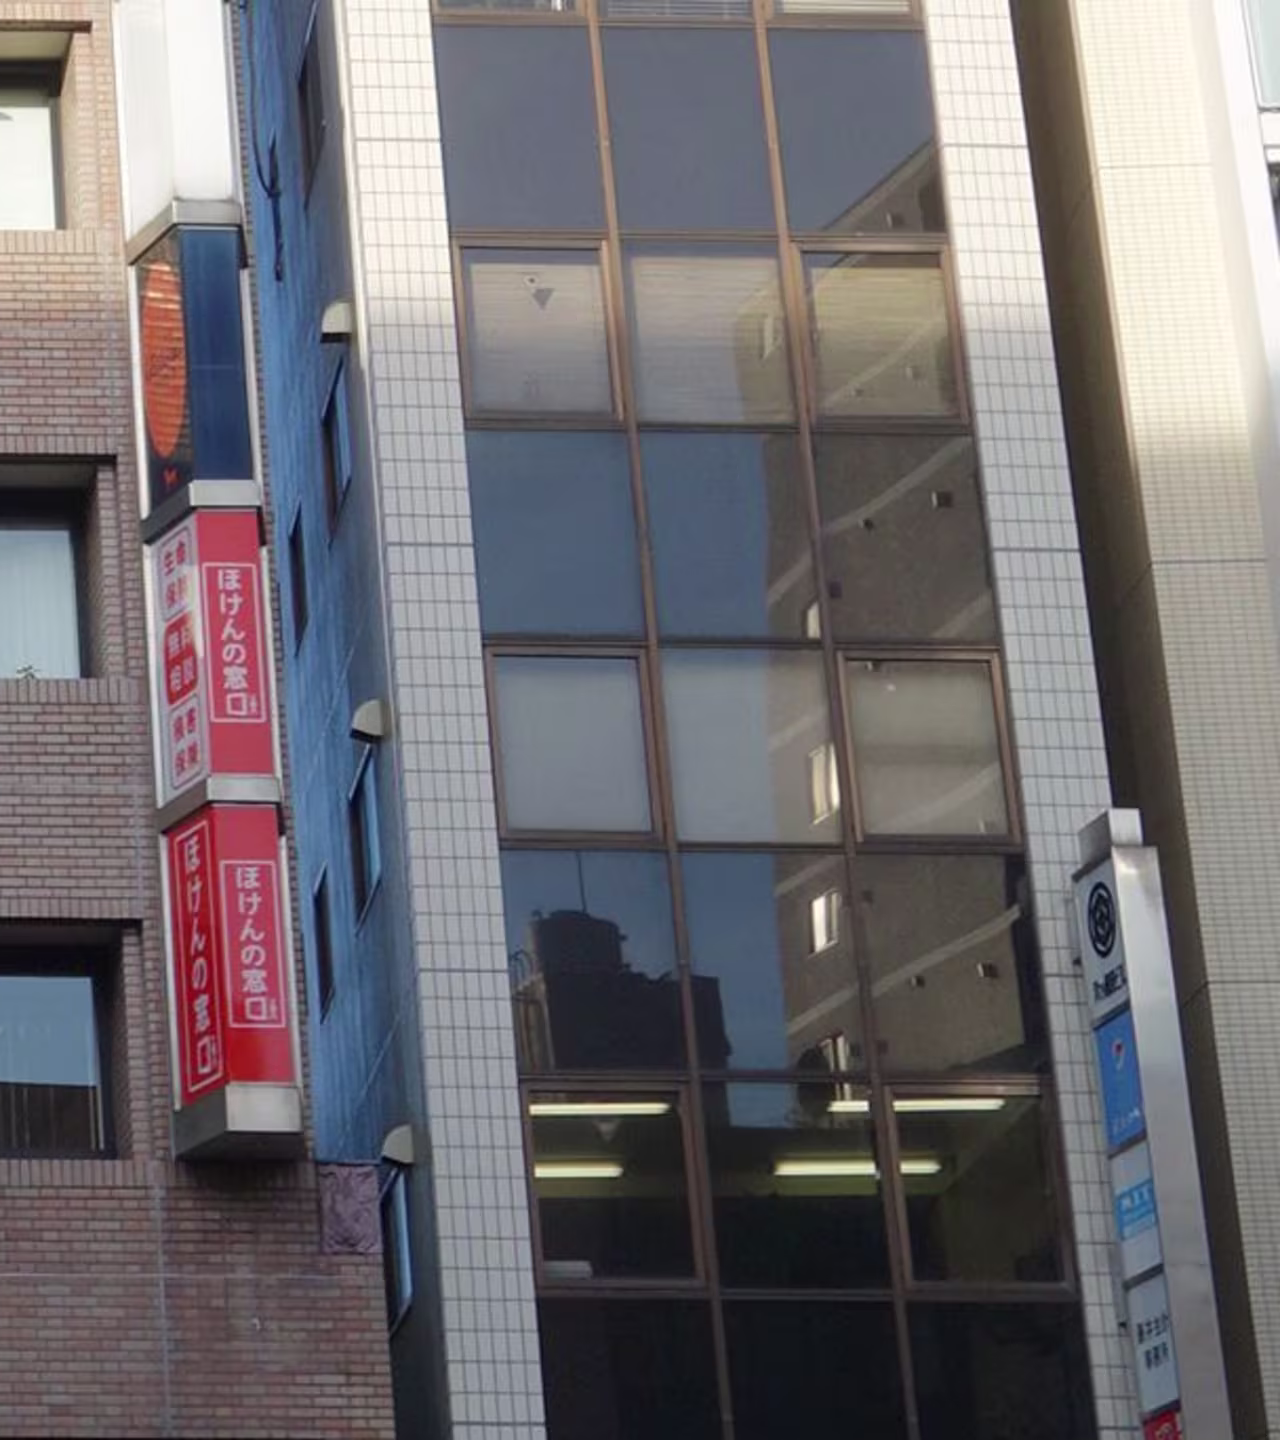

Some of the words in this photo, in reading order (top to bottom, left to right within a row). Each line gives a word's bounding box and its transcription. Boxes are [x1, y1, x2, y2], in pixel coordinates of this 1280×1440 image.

[217, 568, 248, 717] ほけんの窓口
[183, 836, 212, 1075] ほけんの窓口
[236, 866, 268, 1021] ほけんの窓口
